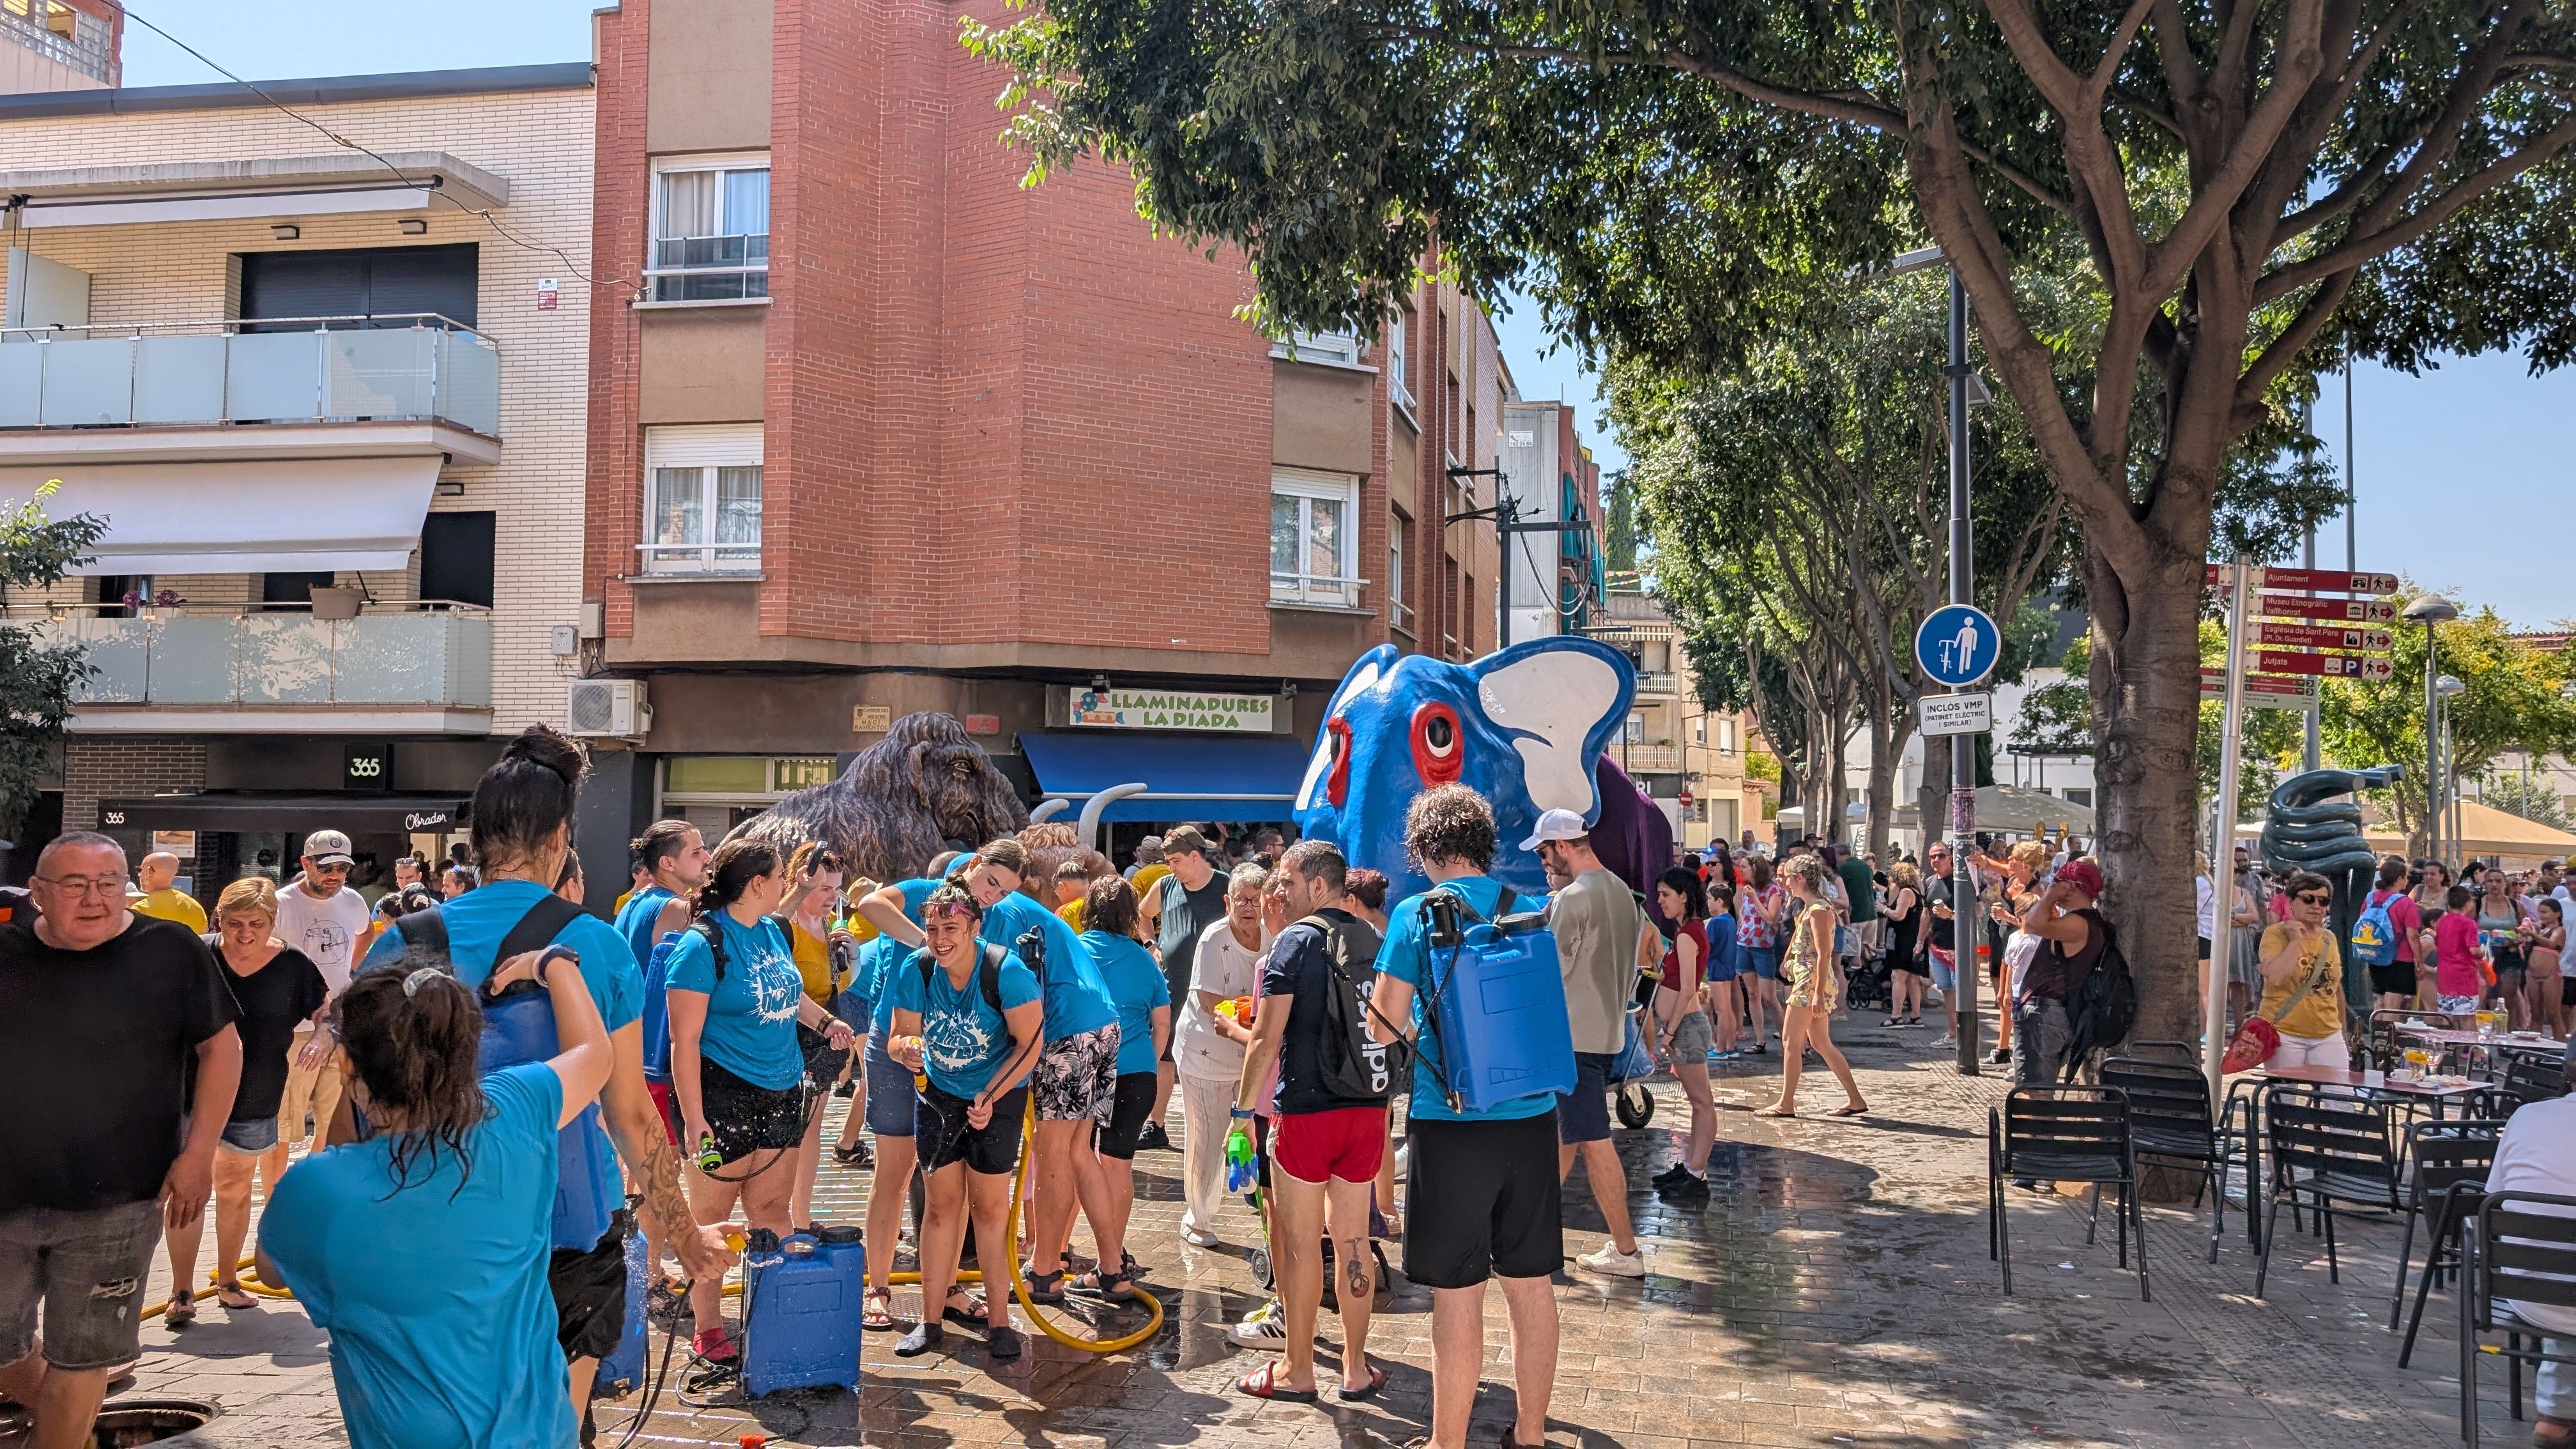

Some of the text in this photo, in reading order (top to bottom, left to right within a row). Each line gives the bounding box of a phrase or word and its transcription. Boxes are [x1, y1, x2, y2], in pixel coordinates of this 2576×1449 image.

[2267, 574, 2309, 583] Ajuntament
[2266, 597, 2328, 609] Museu Etnogràfic
[2266, 607, 2301, 616] Vallhonrat
[2264, 625, 2294, 634] Església
[2304, 627, 2321, 636] Sant
[2322, 629, 2339, 637] Pere
[2263, 657, 2288, 666] Jutjats
[1111, 693, 1269, 713] LLAMINADURES
[1964, 700, 1983, 710] VMP
[1143, 711, 1239, 728] LA DIADA
[1924, 714, 1953, 722] (PATINET
[1943, 719, 1972, 728] SIMILAR)
[350, 758, 380, 776] 365
[105, 812, 125, 824] 365
[405, 811, 447, 830] Obrador
